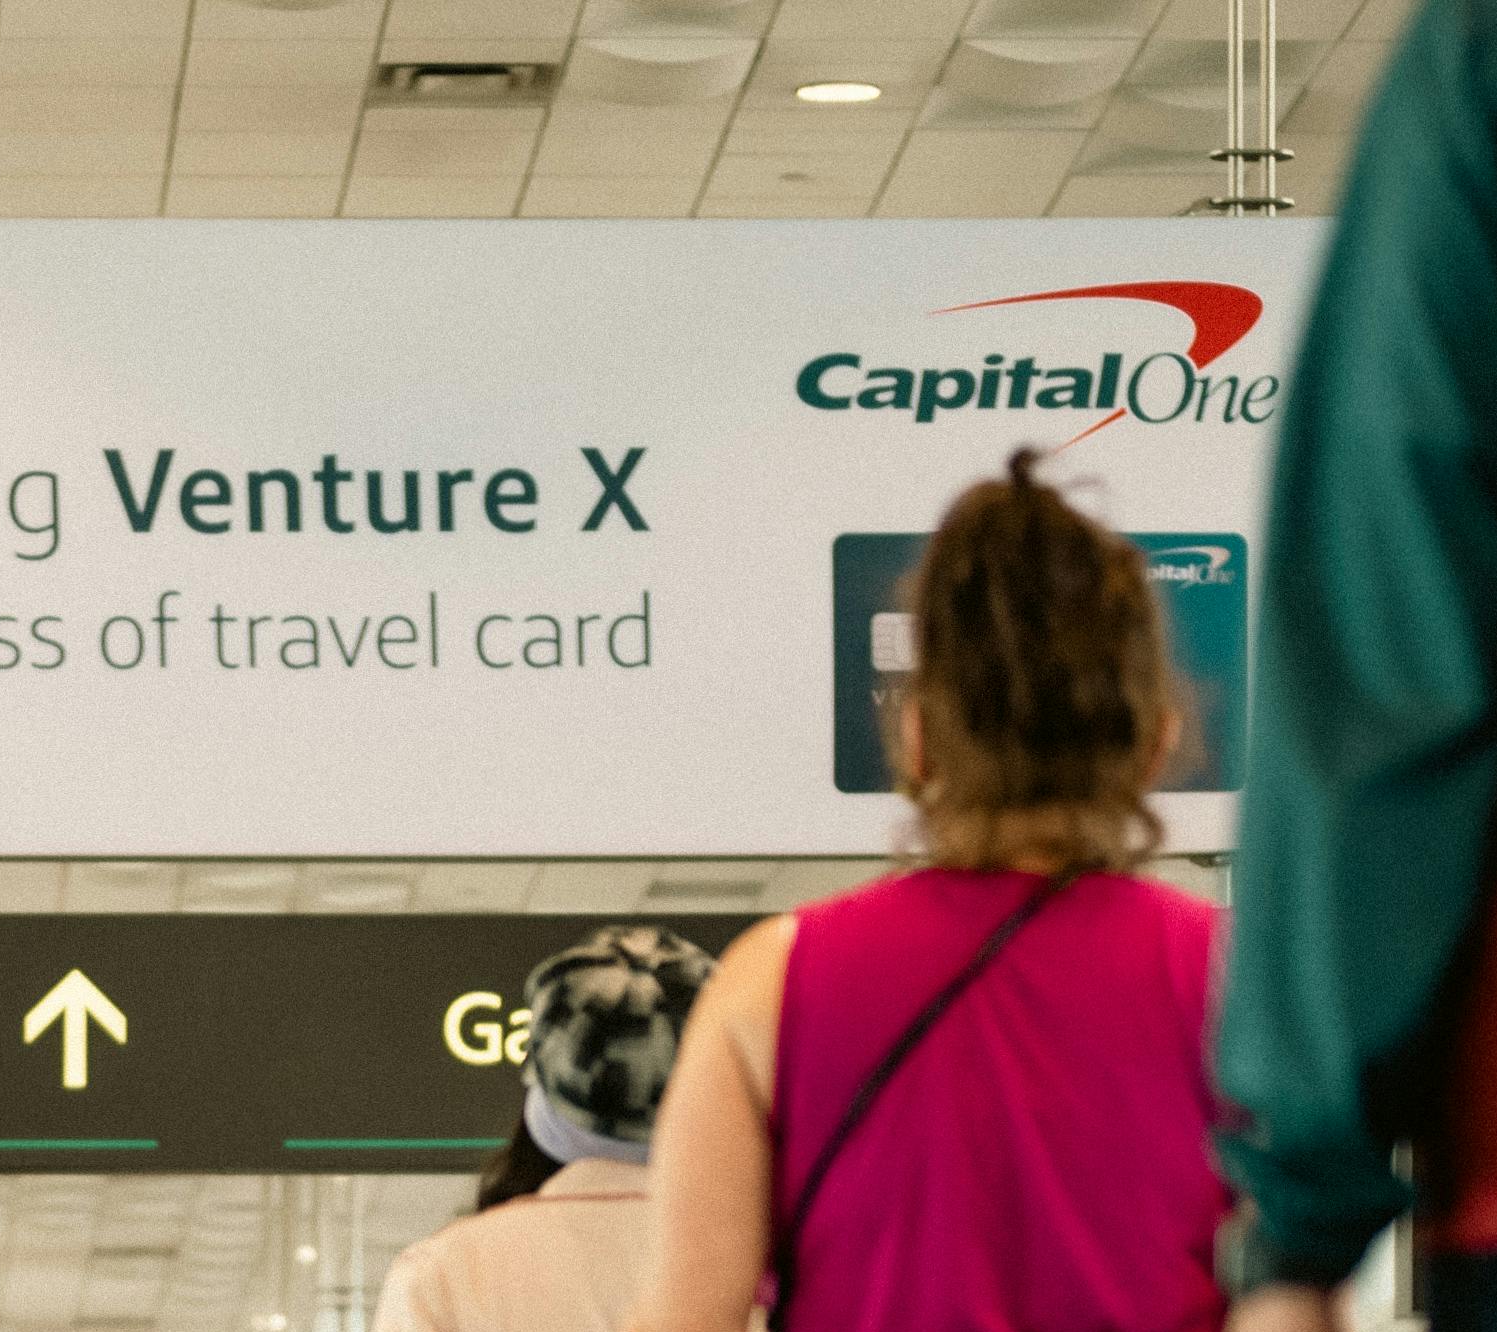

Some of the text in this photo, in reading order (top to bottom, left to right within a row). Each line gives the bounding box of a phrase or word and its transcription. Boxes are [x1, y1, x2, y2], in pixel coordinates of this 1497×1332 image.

[102, 447, 540, 534] Venture
[579, 446, 651, 533] X
[99, 590, 182, 670] of
[210, 590, 440, 670] travel
[475, 590, 652, 670] card
